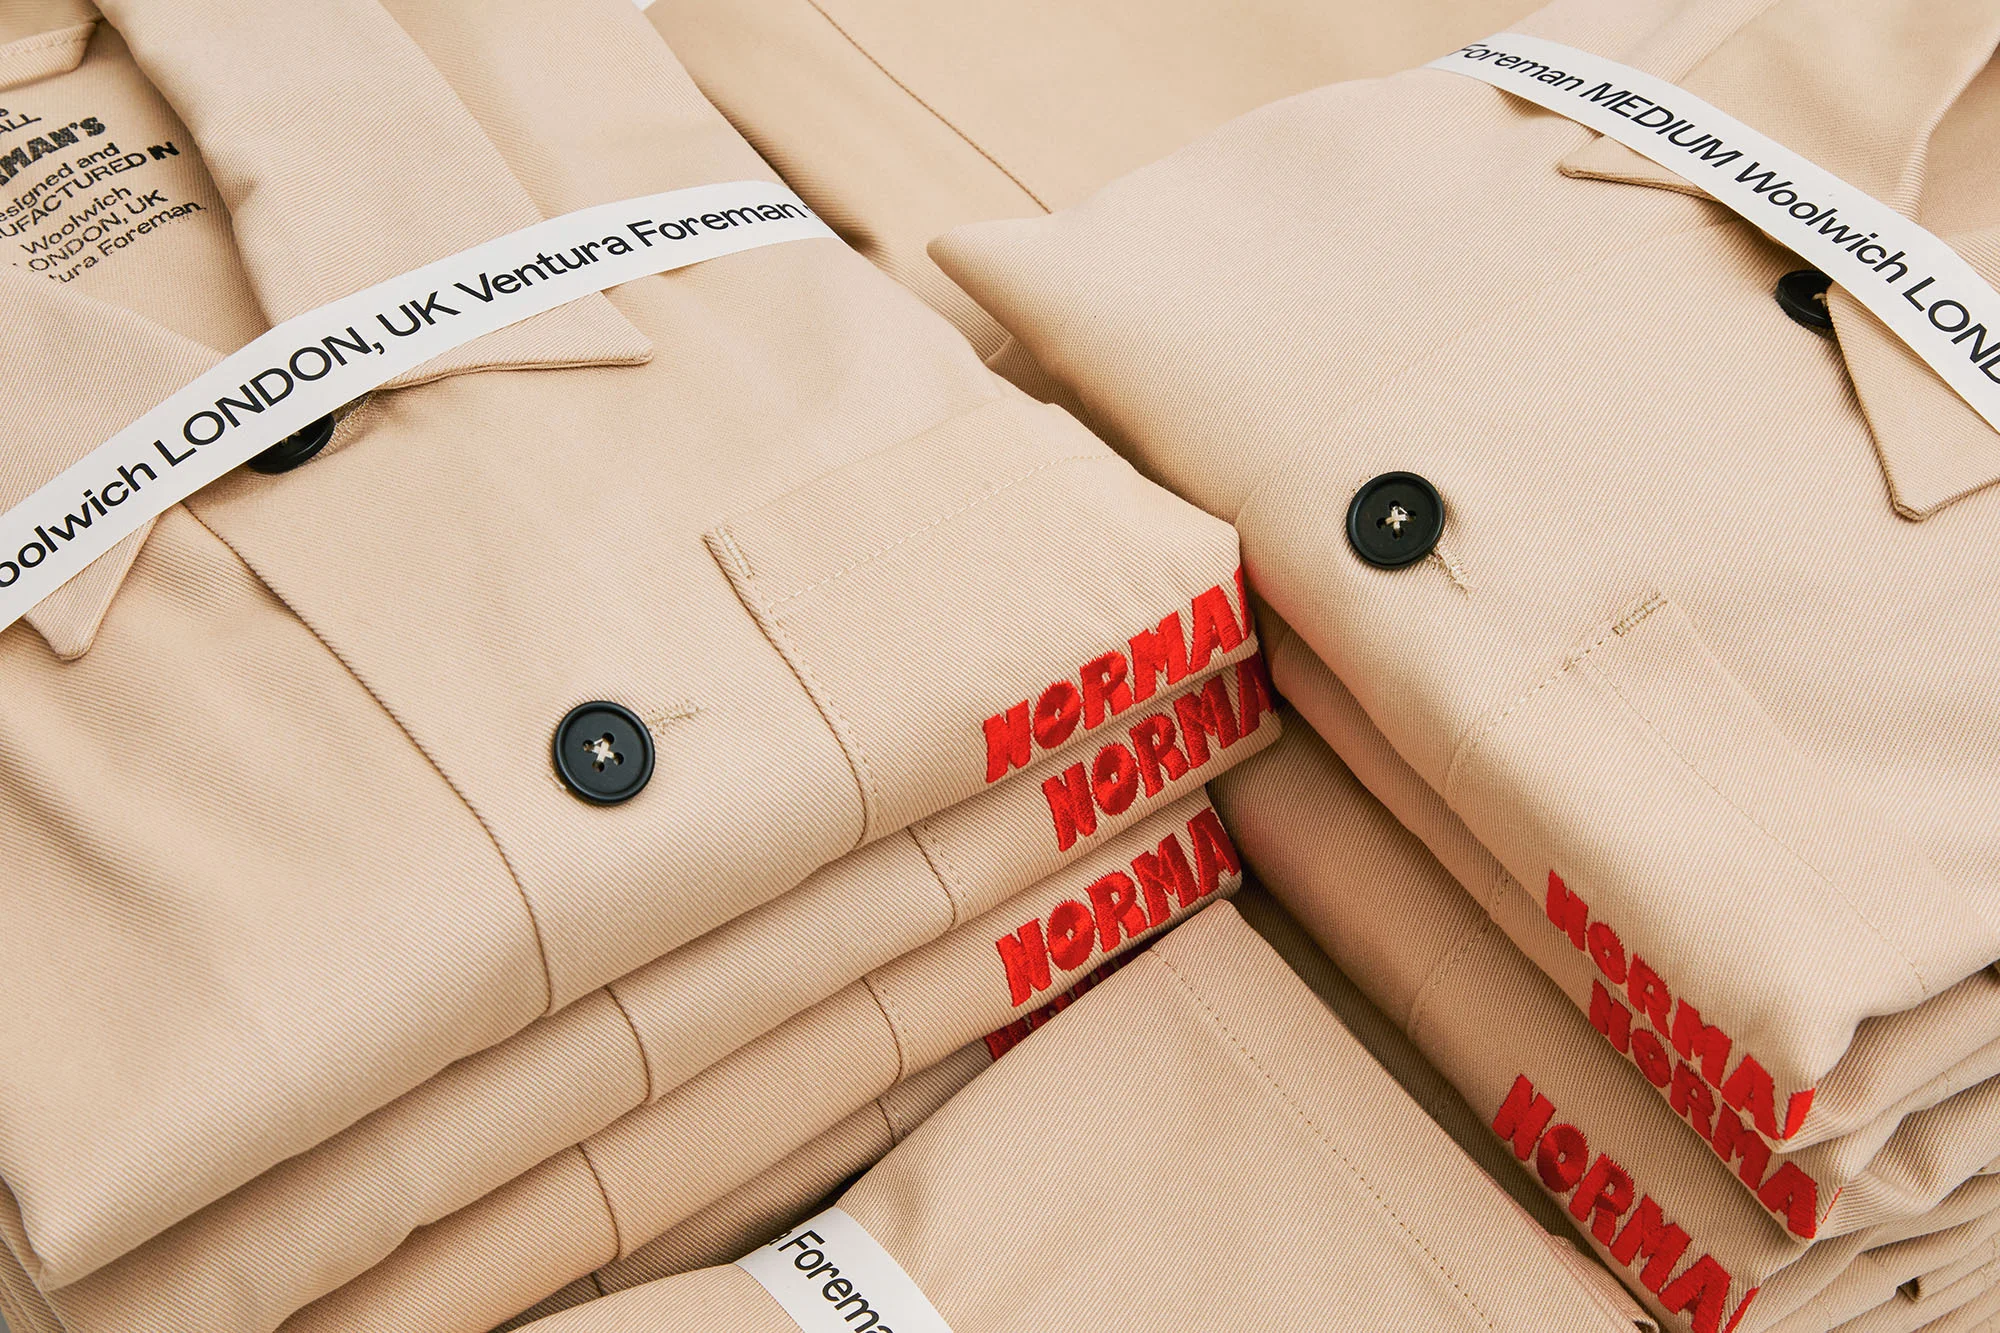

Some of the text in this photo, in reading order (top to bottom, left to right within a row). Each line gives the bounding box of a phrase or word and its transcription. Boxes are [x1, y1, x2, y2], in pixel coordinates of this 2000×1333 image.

[0, 116, 106, 186] MAN'S
[0, 152, 147, 238] UFACTURED
[20, 186, 132, 254] Woolwich
[76, 142, 121, 168] and
[1448, 44, 1585, 92] Foreman
[1579, 82, 1741, 168] MEDIUM
[1735, 162, 1908, 284] Woolwich
[13, 189, 169, 272] ONDON, UK
[153, 325, 386, 467] LONDON,
[375, 290, 462, 337] UK
[453, 234, 632, 303] Ventura
[626, 201, 807, 247] Foreman
[996, 807, 1240, 1007] NORMA
[1589, 978, 1843, 1239] NORMA
[1492, 1074, 1760, 1333] NORMA
